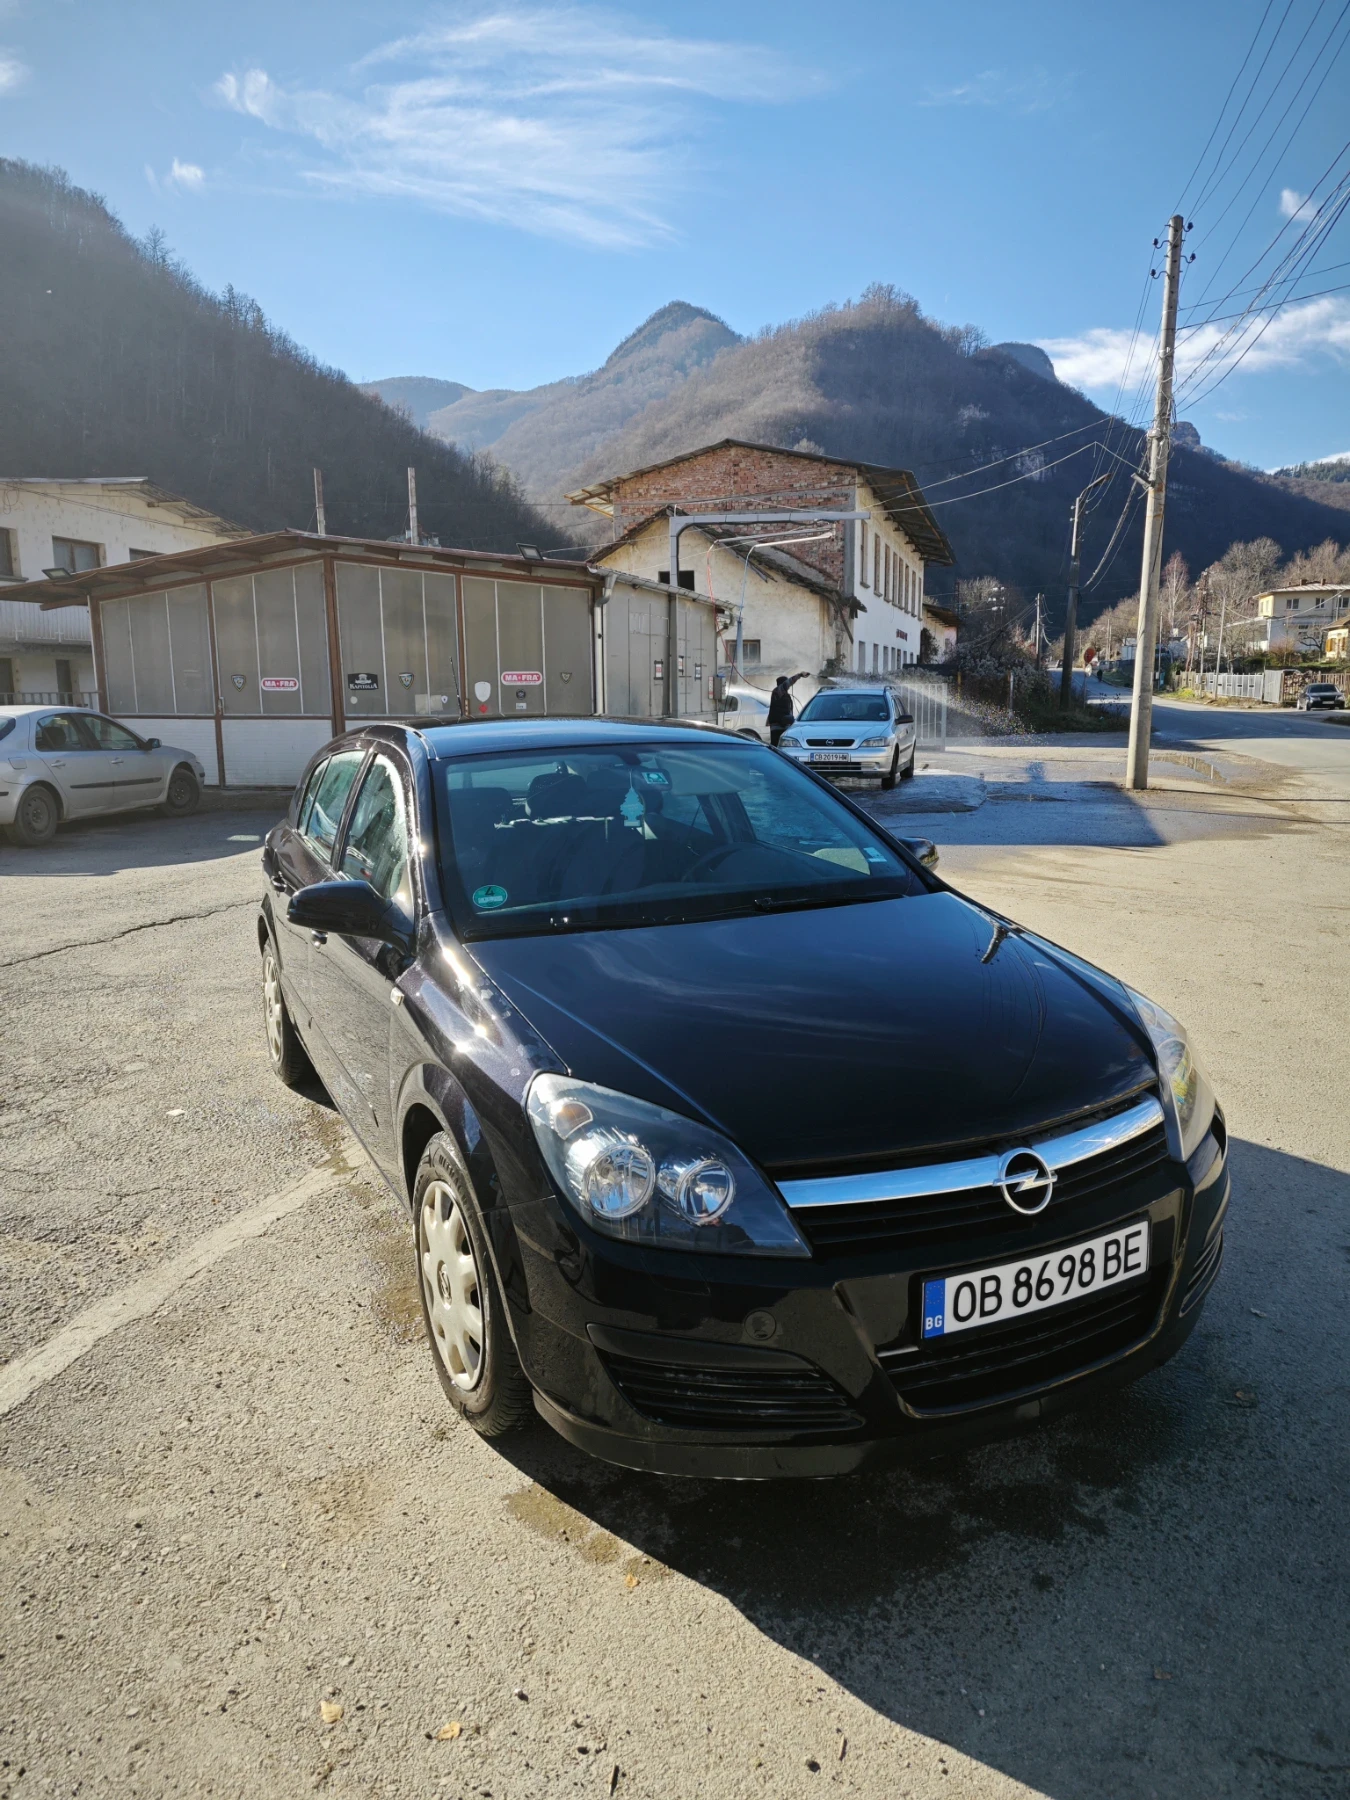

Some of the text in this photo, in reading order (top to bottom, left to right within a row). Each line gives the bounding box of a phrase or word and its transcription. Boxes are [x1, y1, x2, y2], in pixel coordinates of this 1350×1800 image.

[952, 1229, 1142, 1323] OB 8698 BE
[925, 1315, 943, 1330] BG
